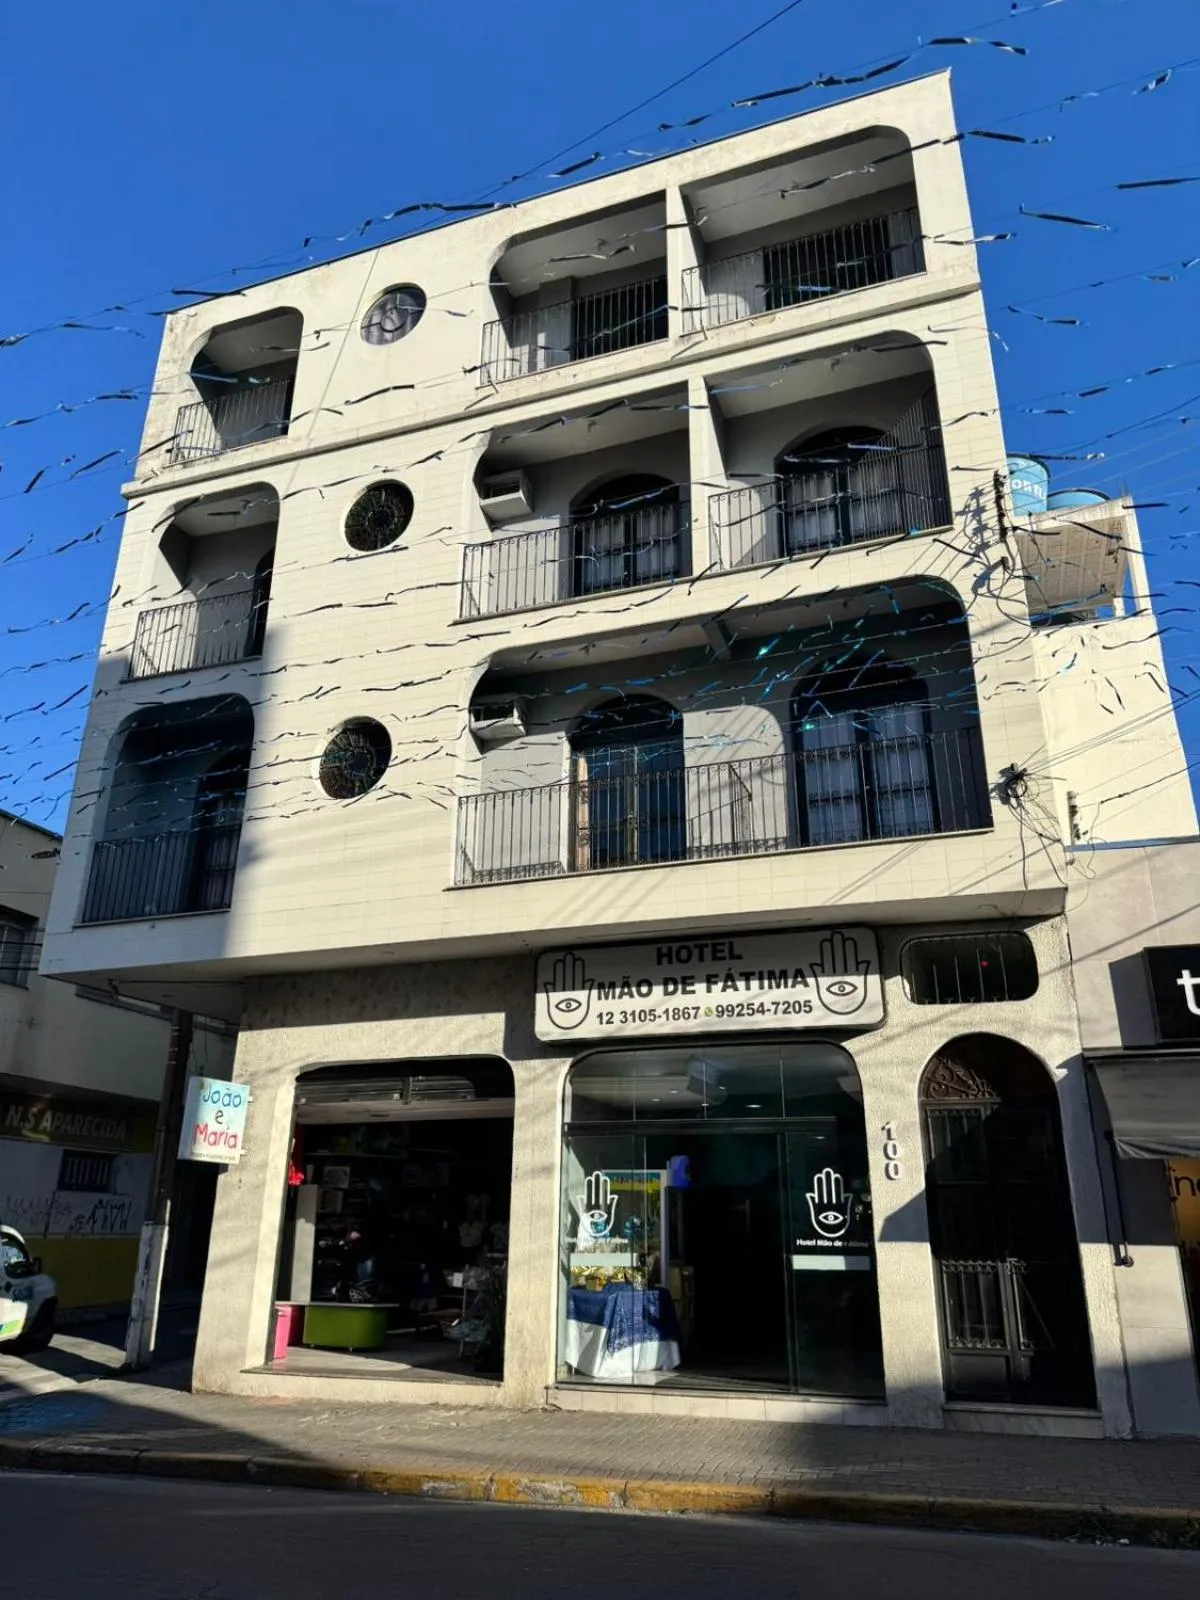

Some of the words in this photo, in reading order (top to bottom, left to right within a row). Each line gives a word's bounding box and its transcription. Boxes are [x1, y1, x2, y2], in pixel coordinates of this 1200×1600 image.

[656, 941, 743, 966] HOTEL
[597, 975, 653, 1000] MÃO
[662, 975, 696, 997] DE
[705, 967, 810, 994] FÁTIMA
[597, 1011, 615, 1025] 12
[619, 1006, 701, 1024] 3105-1867
[715, 1000, 813, 1018] 99254-7205
[203, 1084, 242, 1107] João
[39, 1109, 129, 1141] APARECIDA
[215, 1109, 224, 1124] e
[193, 1123, 238, 1149] Maria
[881, 1121, 903, 1181] 100
[796, 1238, 816, 1246] Hotel
[833, 1239, 843, 1247] de
